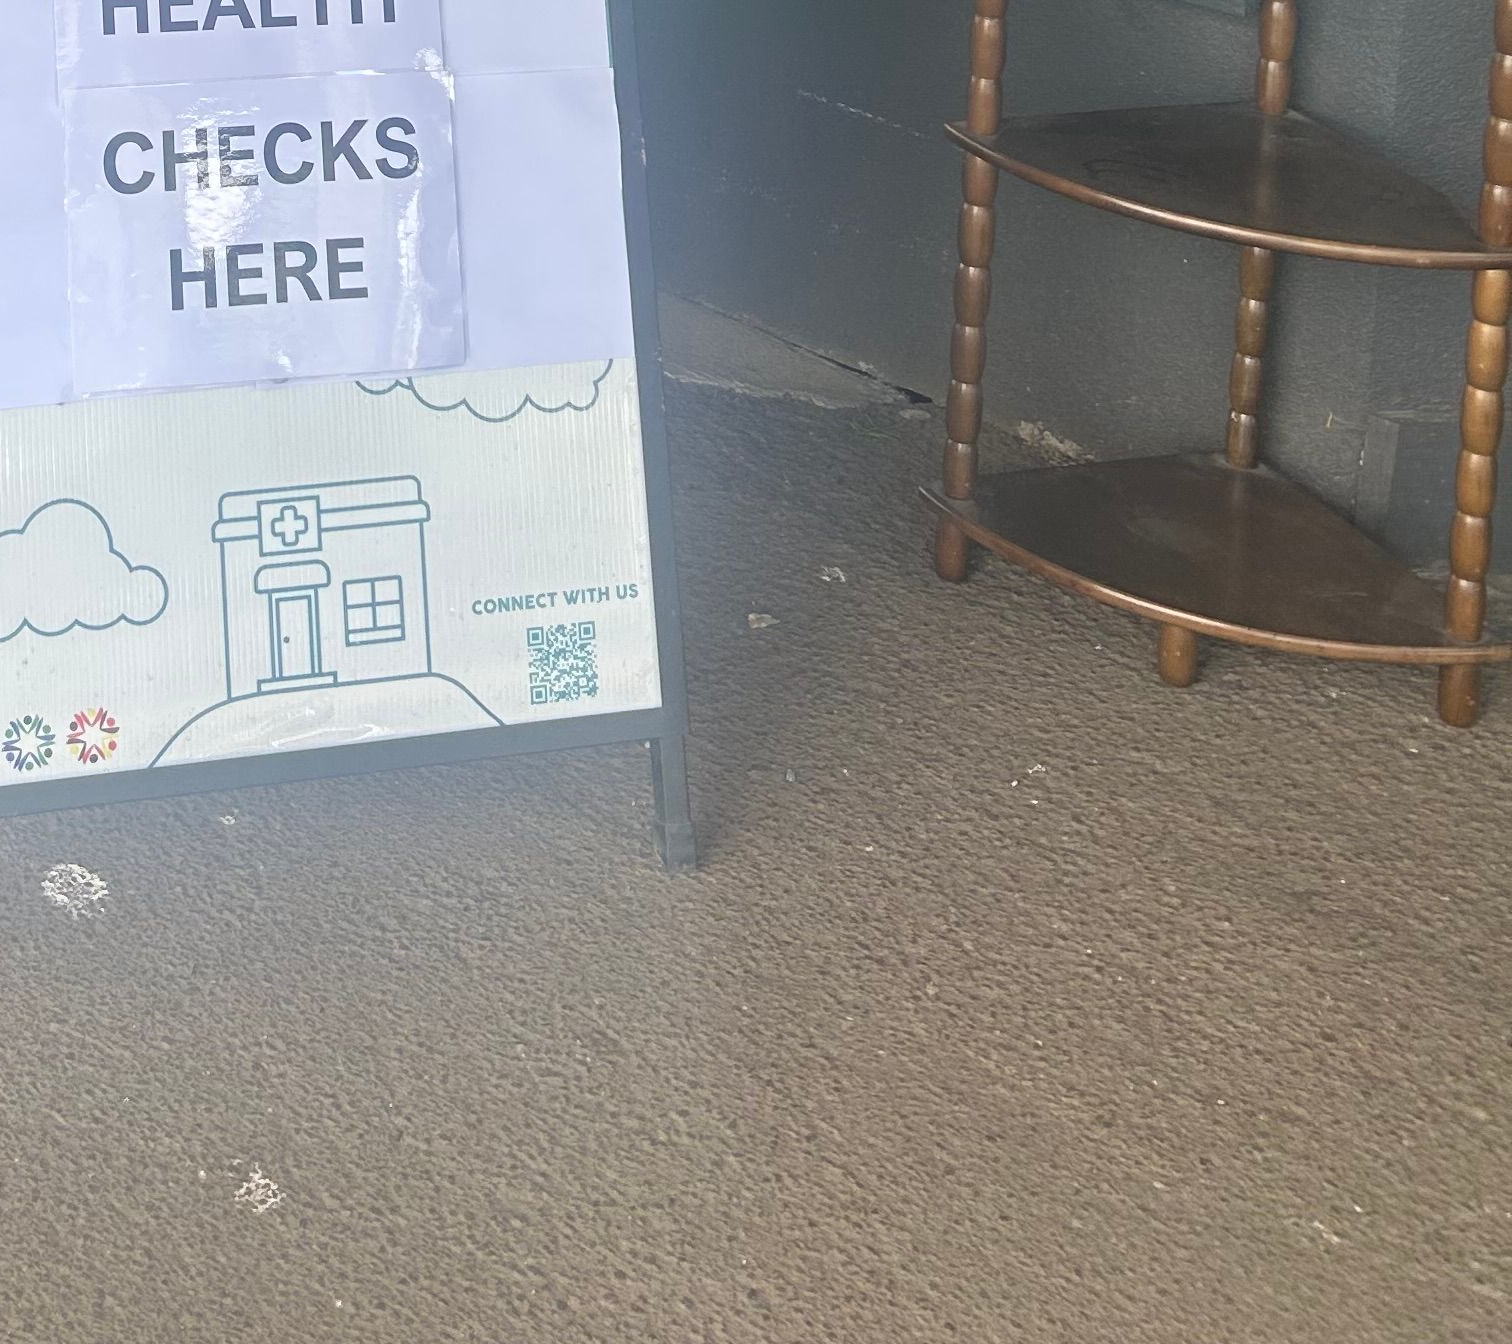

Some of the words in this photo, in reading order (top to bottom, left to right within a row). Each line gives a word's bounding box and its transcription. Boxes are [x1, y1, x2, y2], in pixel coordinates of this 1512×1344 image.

[102, 116, 420, 195] CHECKS
[169, 237, 369, 311] HERE
[472, 592, 557, 615] CONNECT
[563, 586, 610, 605] WITH
[615, 583, 639, 600] US
